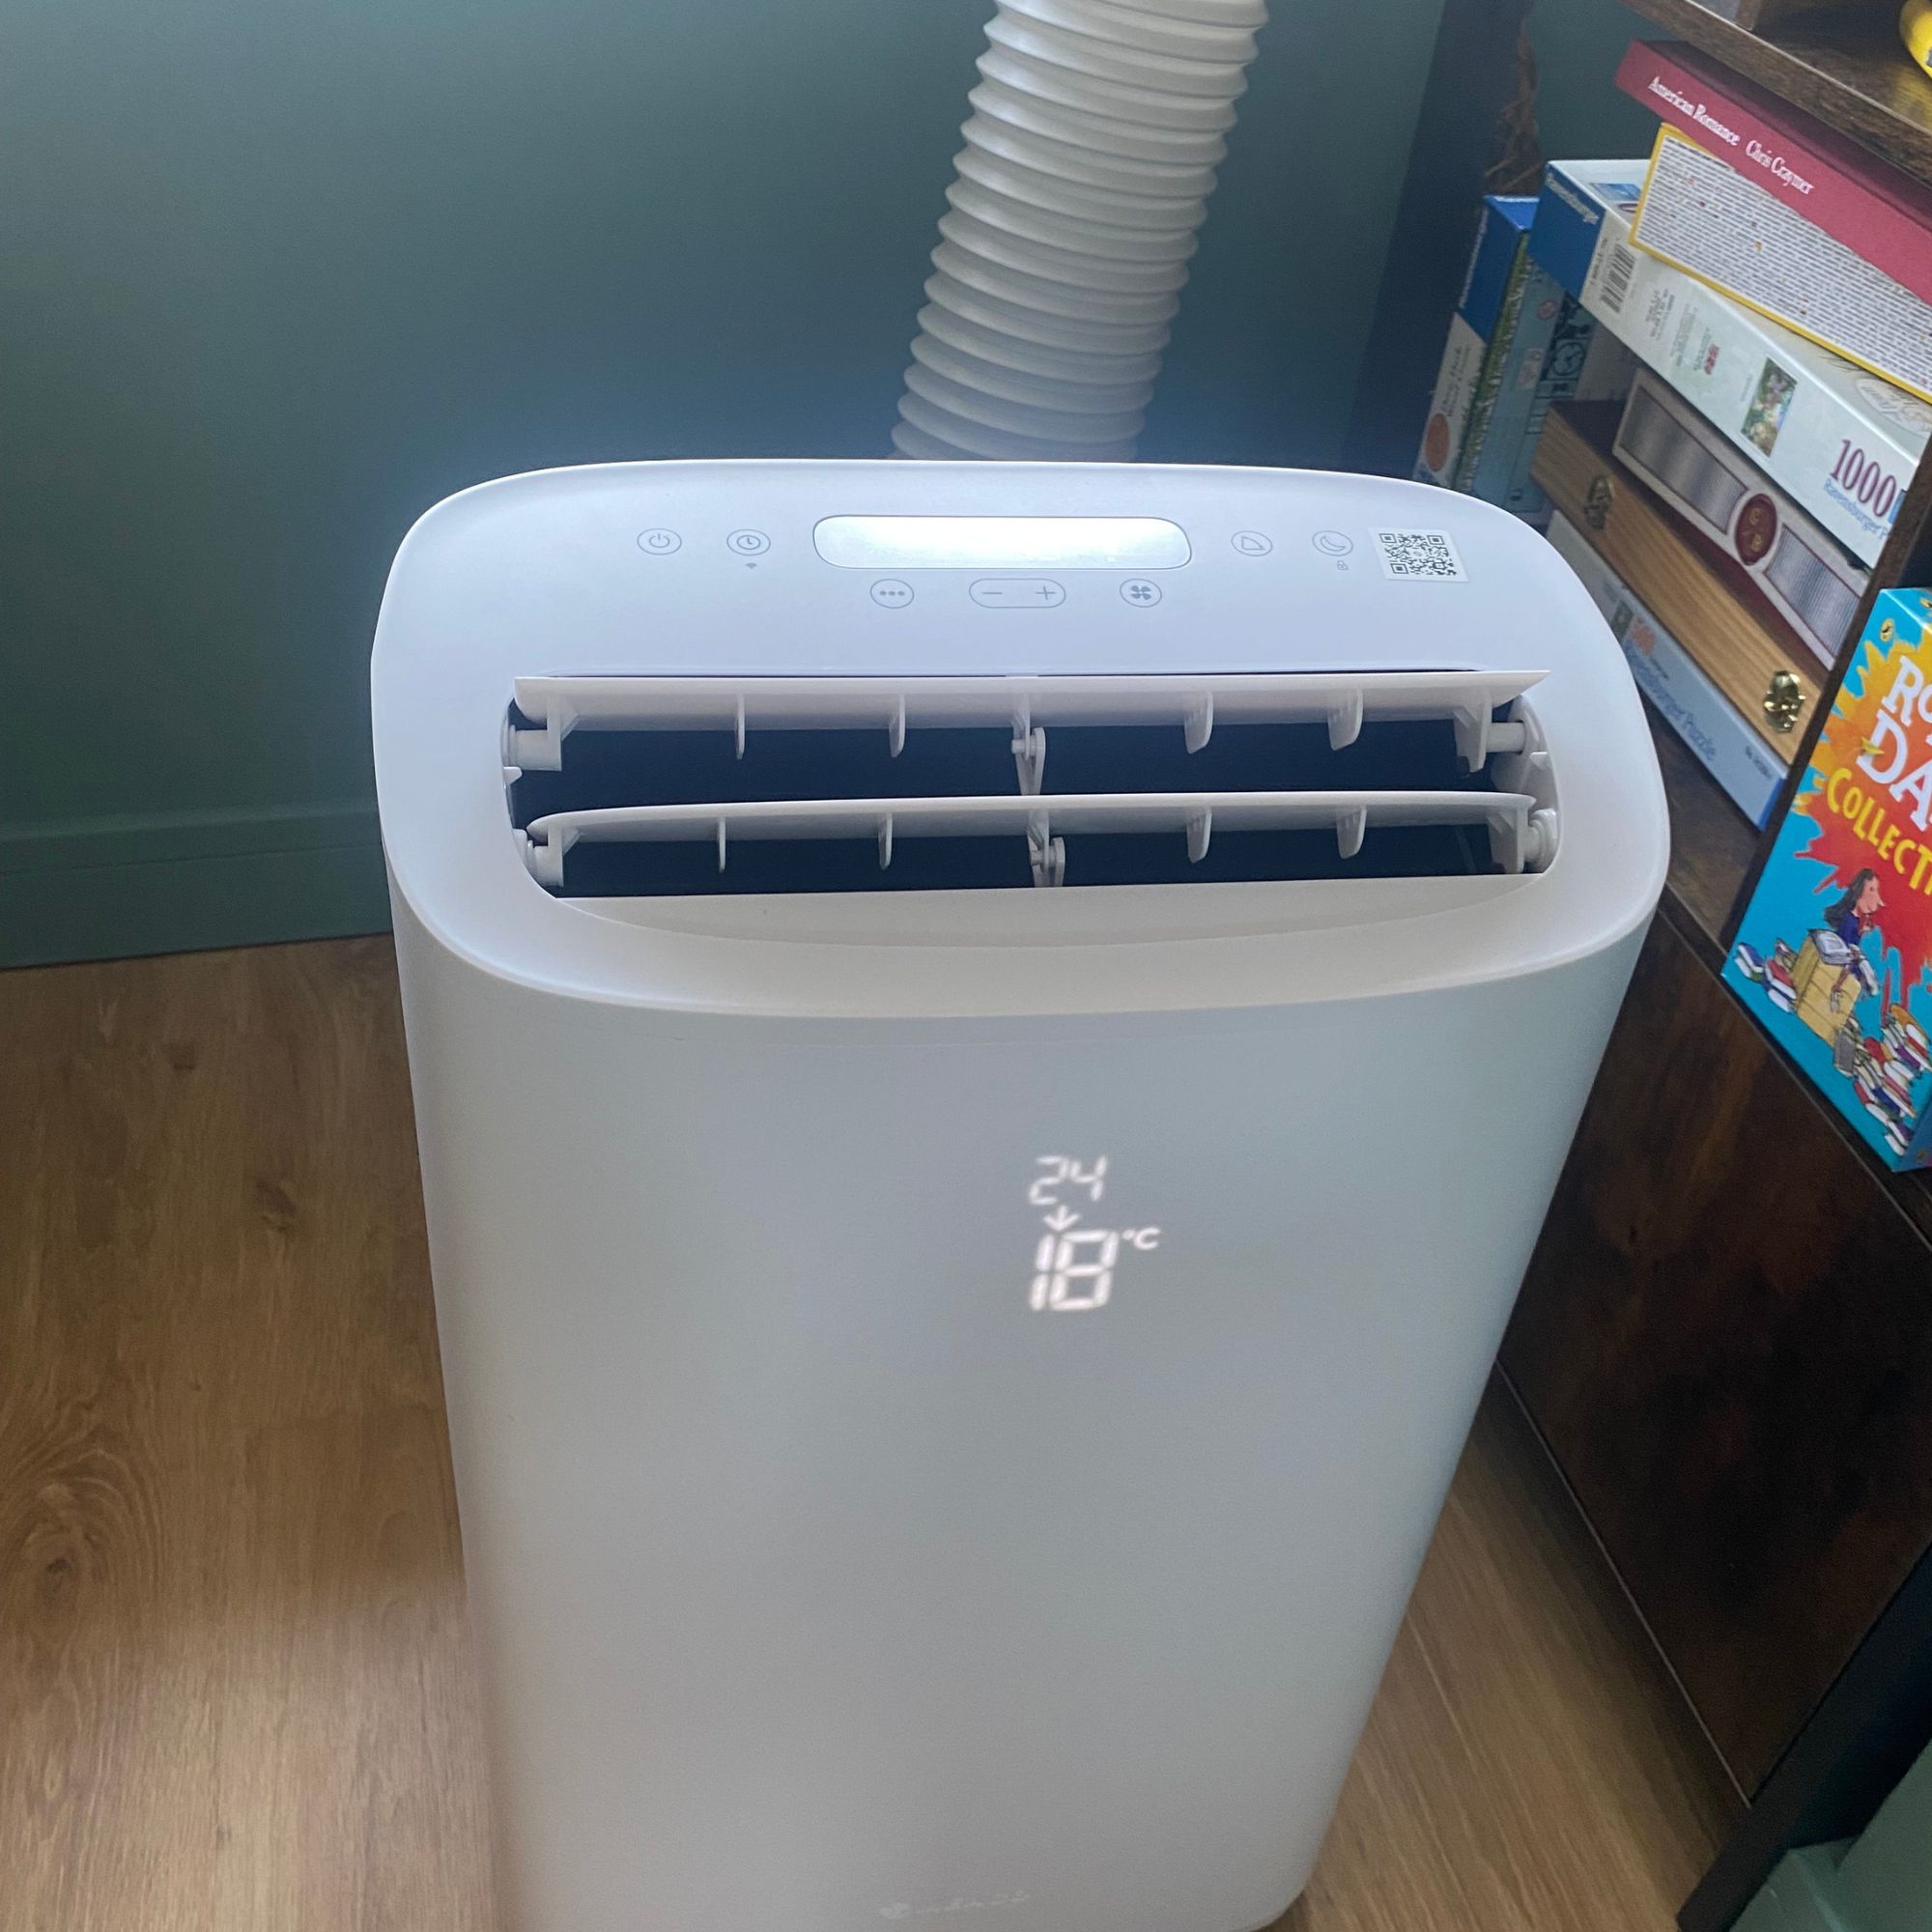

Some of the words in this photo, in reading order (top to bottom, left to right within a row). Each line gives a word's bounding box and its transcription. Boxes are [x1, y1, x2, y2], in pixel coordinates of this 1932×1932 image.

[1648, 76, 1695, 117] American
[1692, 103, 1741, 146] Romance
[1746, 140, 1773, 168] Chris
[1830, 439, 1897, 518] 1000
[1856, 708, 1932, 832] DA
[1029, 1155, 1108, 1206] 24
